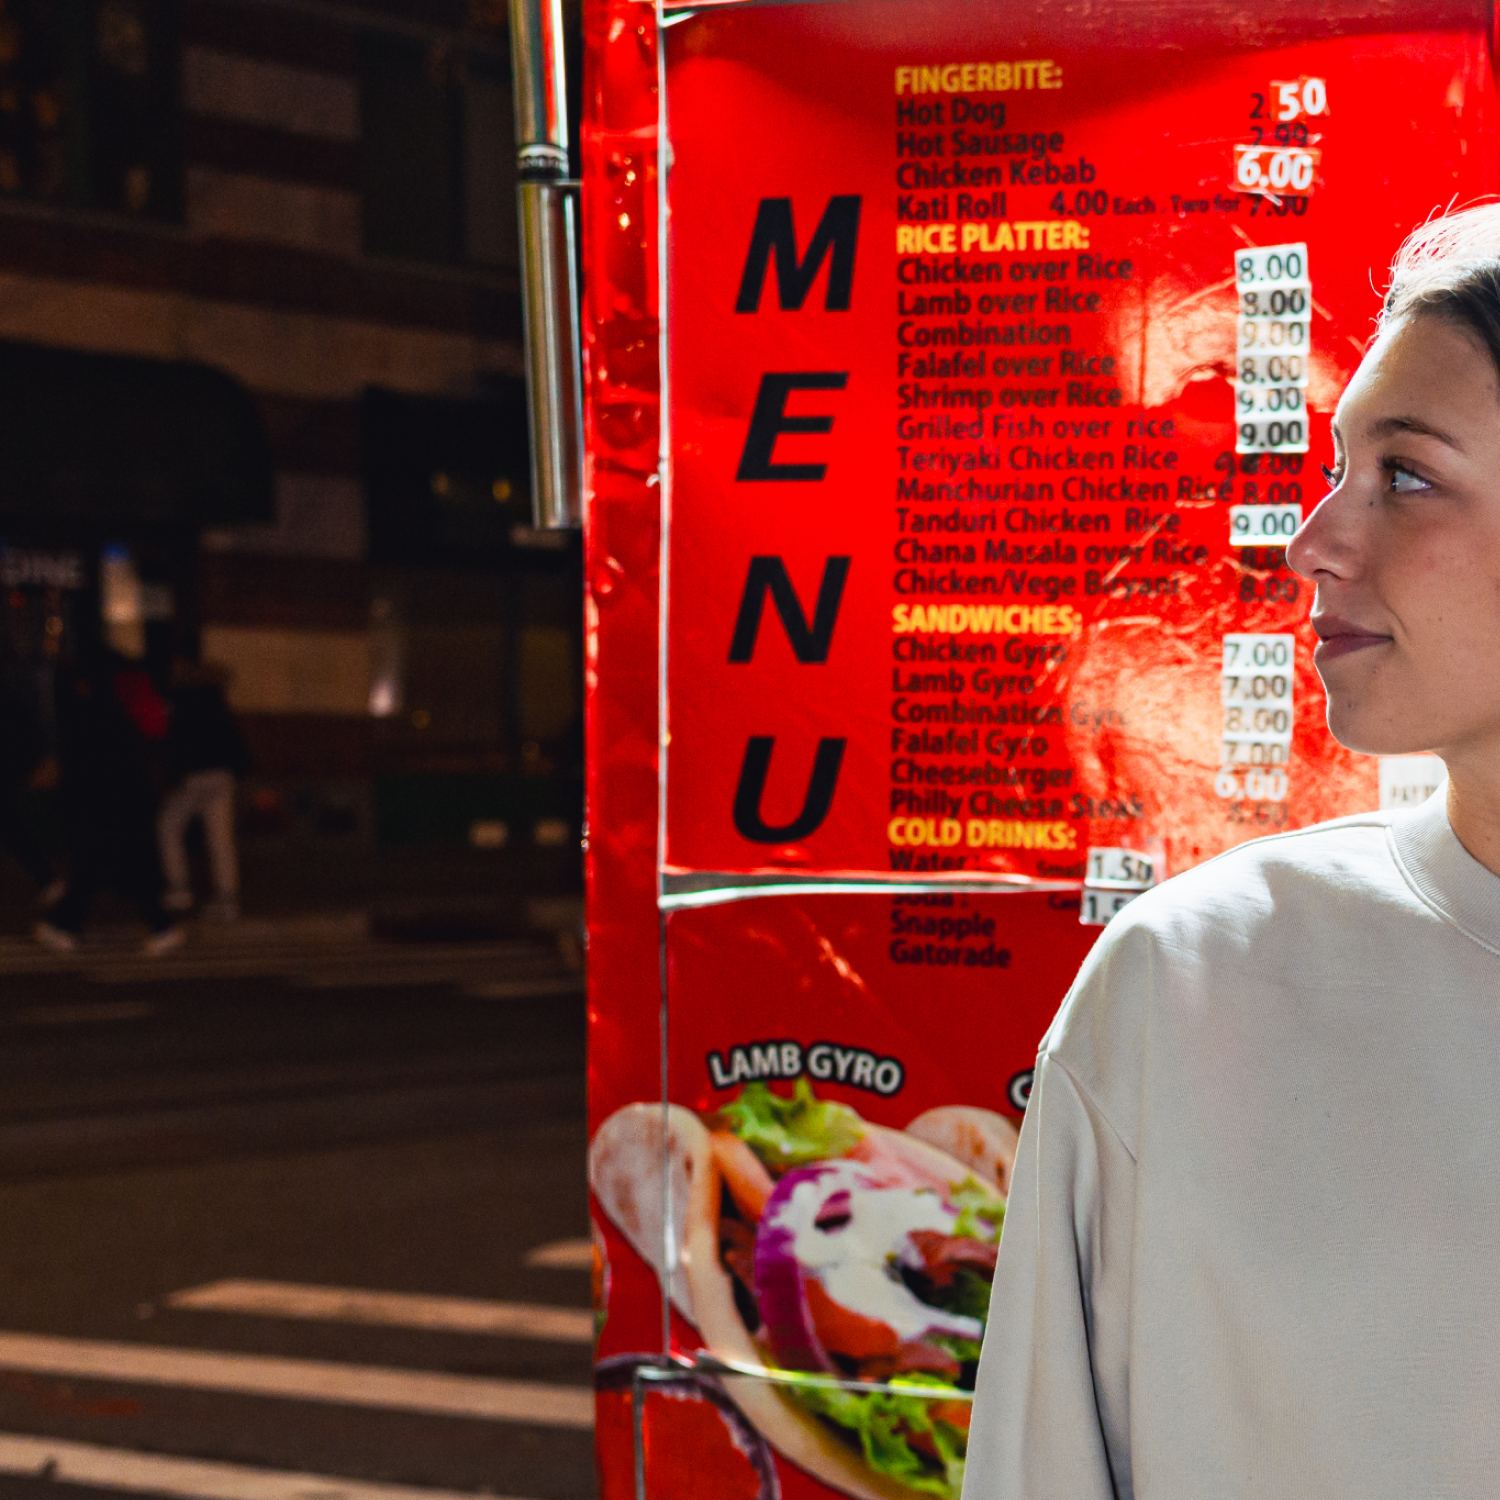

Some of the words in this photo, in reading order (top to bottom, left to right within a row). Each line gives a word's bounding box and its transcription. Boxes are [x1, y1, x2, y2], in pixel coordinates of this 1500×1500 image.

[895, 59, 1063, 95] FINGERBITE:
[897, 99, 944, 126] Hot
[952, 97, 1006, 130] Dog
[897, 132, 944, 158] Hot
[952, 130, 1064, 160] Sausage
[896, 160, 1001, 190] Chicken
[1010, 157, 1096, 186] Kebab
[1237, 151, 1314, 190] 6.00
[897, 193, 948, 221] Kati
[956, 191, 1007, 220] Roll
[1050, 189, 1109, 217] 4.00
[1113, 196, 1156, 215] Each
[896, 223, 956, 254] RICE
[961, 219, 1090, 252] PLATTER:
[897, 256, 1001, 285] Chicken
[1009, 260, 1070, 283] over
[1077, 253, 1134, 282] Rice
[1239, 252, 1302, 284] 8.00
[897, 288, 971, 316] Lamb
[978, 292, 1038, 315] over
[1045, 286, 1102, 313] Rice
[1243, 289, 1306, 317] 8.00
[897, 319, 1071, 347] Combination
[898, 350, 985, 379] Falafel
[993, 355, 1053, 378] over
[1060, 350, 1116, 378] Rice
[1240, 355, 1302, 384] 8.00
[897, 382, 993, 413] Shrimp
[1000, 387, 1059, 408] over
[1067, 380, 1123, 408] Rice
[1238, 387, 1301, 414] 9.00
[897, 412, 983, 440] Grilled
[993, 413, 1045, 440] Fish
[1052, 418, 1111, 440] over
[1127, 413, 1176, 439] rice
[1240, 420, 1304, 448] 9.00
[897, 446, 1000, 477] Teriyaki
[1008, 444, 1115, 471] Chicken
[1123, 444, 1179, 471] Rice
[897, 477, 1054, 501] Manchurian
[1062, 475, 1169, 502] Chicken
[1177, 475, 1234, 502] Rice
[1243, 481, 1302, 505] 8.00
[727, 194, 862, 845] MENU
[896, 507, 997, 533] Tanduri
[1004, 506, 1111, 533] Chicken
[1125, 507, 1181, 534] Rice
[1234, 512, 1297, 536] 9.00
[894, 538, 976, 564] Chana
[983, 538, 1076, 565] Masala
[1084, 543, 1146, 565] over
[1153, 539, 1209, 565] Rice
[893, 568, 1077, 602] Chicken/Vege
[1084, 569, 1180, 602] Biryani
[1240, 575, 1299, 603] 8.00
[892, 603, 1083, 635] SANDWICHES:
[892, 636, 997, 663] Chicken
[1003, 637, 1068, 670] Gyro
[1224, 641, 1288, 667] 7.00
[892, 668, 965, 694] Lamb
[972, 667, 1035, 700] Gyro
[1224, 674, 1288, 701] 7.00
[891, 696, 1062, 726] Combination
[890, 727, 979, 754] Falafel
[985, 730, 1048, 761] Gyro
[890, 758, 1075, 794] Cheeseburger
[890, 788, 963, 819] Philly
[968, 790, 1063, 819] Cheese
[887, 815, 961, 848] COLD
[966, 819, 1077, 850] DRINKS:
[889, 849, 966, 872] Water
[890, 908, 996, 941] Snapple
[889, 938, 1012, 970] Gatorade
[708, 1042, 802, 1088] LAMB
[807, 1043, 903, 1095] GYRO
